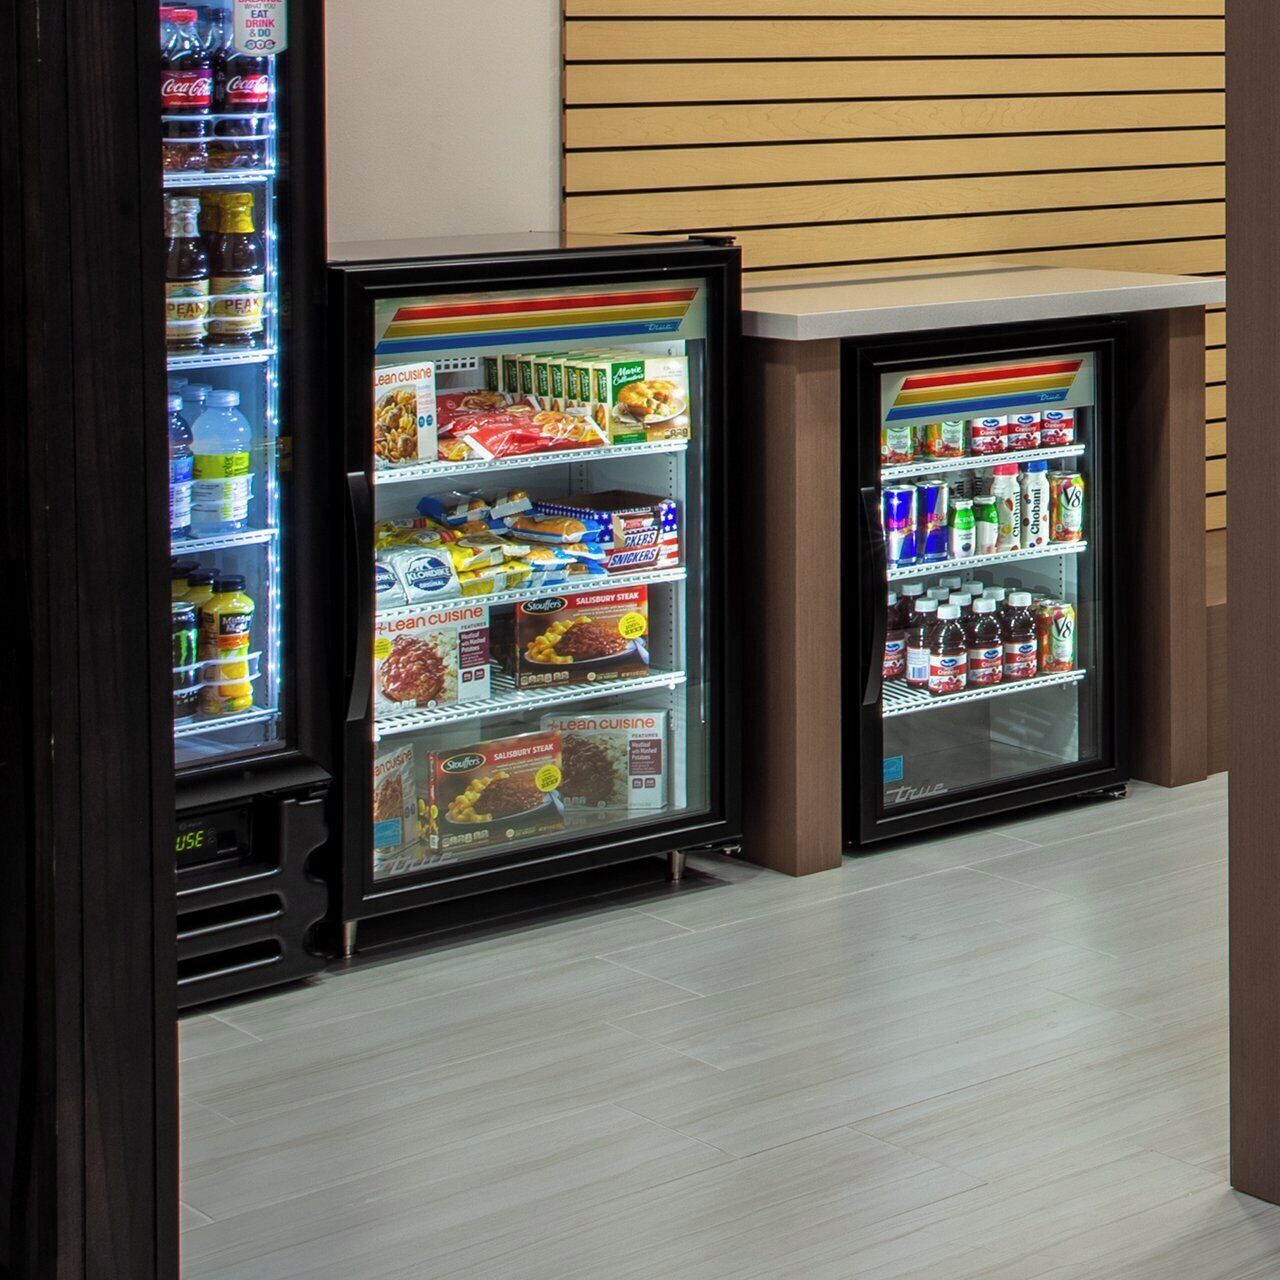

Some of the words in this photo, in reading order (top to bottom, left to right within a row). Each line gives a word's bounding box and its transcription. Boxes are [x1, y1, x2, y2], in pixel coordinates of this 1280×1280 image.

[251, 9, 269, 19] EAT
[245, 19, 275, 28] DRINK
[258, 28, 271, 38] DO
[224, 298, 261, 310] PEAK
[1063, 486, 1081, 508] V8
[1012, 491, 1020, 537] Chobani
[1030, 488, 1041, 535] Chobani
[610, 549, 657, 567] SNICKERS
[405, 567, 452, 586] KLONDIKE
[526, 599, 562, 612] Stouffer's
[575, 594, 615, 606] SALISBURY
[616, 591, 640, 601] STEAK
[387, 616, 426, 633] Lean
[1053, 616, 1073, 639] V8
[560, 720, 597, 731] Lean
[493, 747, 532, 761] SALISBURY
[532, 743, 555, 754] STEAK
[447, 756, 481, 771] Stouffer's
